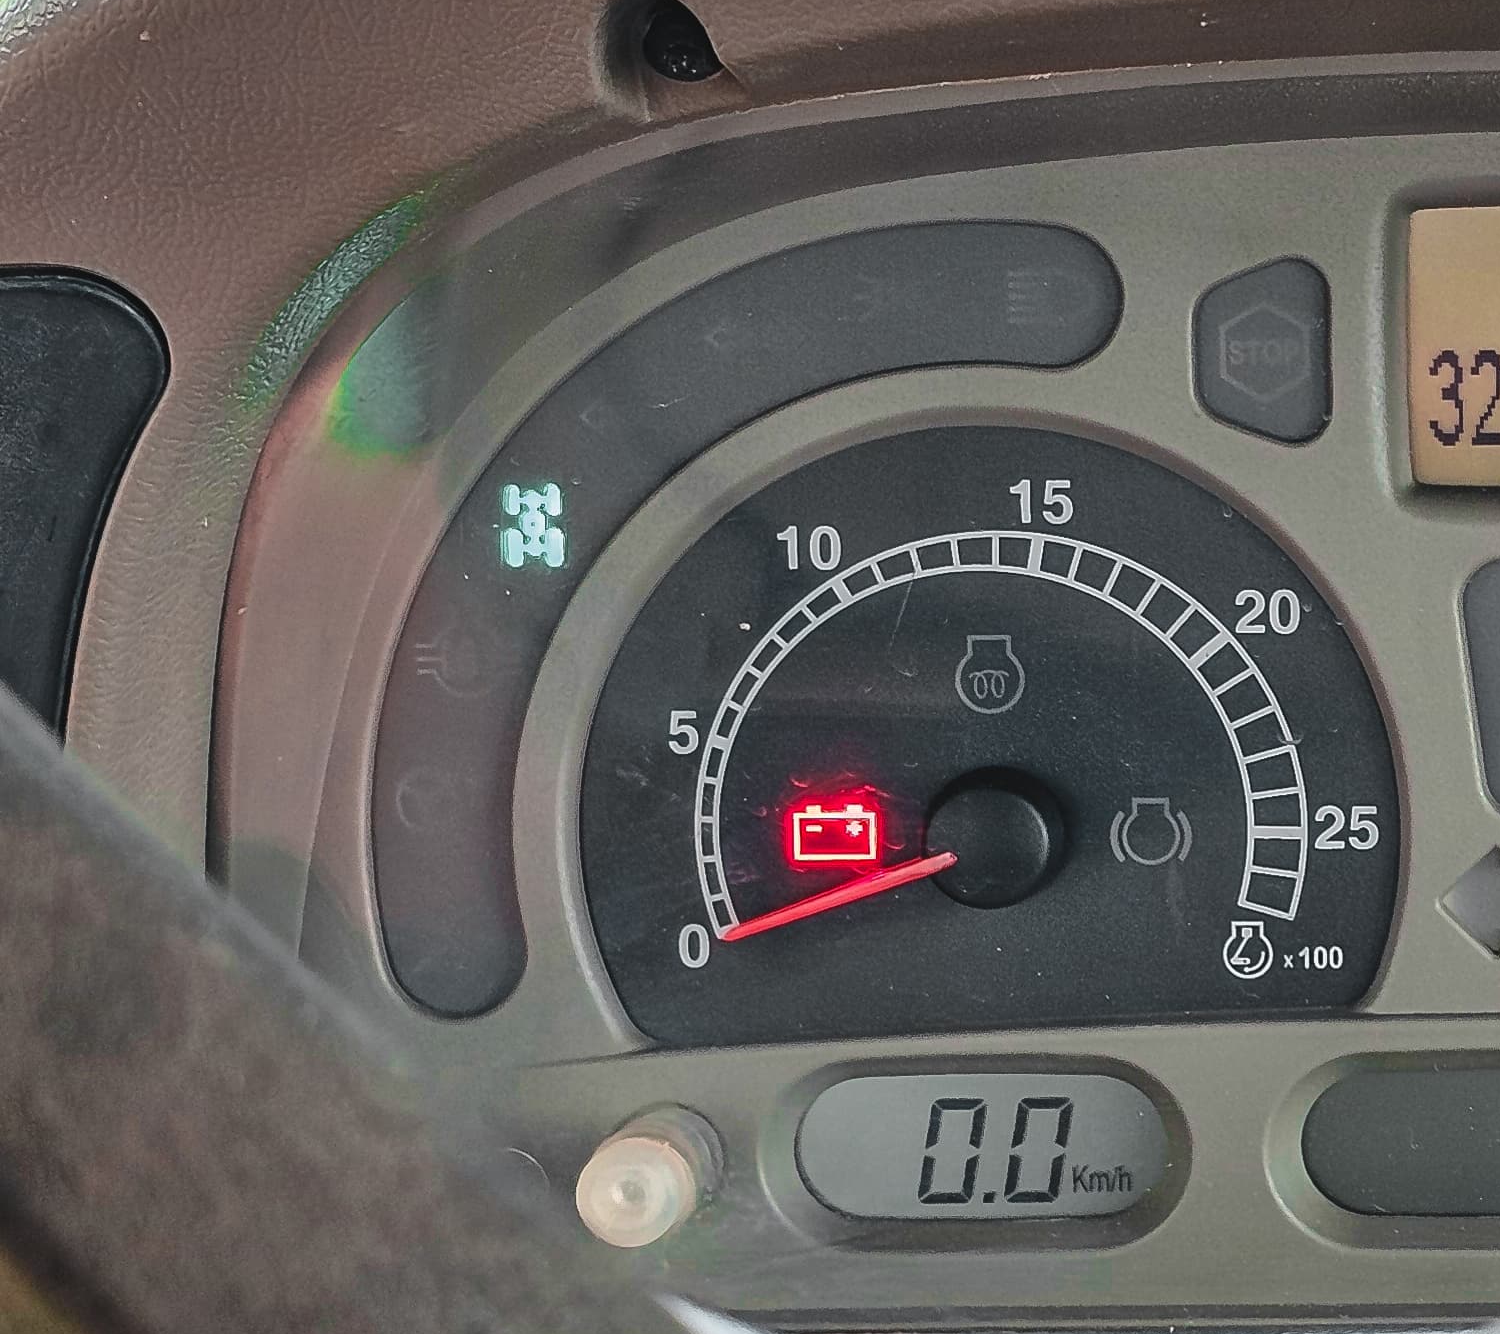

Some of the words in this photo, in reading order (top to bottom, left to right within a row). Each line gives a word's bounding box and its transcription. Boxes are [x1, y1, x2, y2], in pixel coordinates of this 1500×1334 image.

[1228, 338, 1303, 366] STOP
[1009, 478, 1075, 525] 15
[776, 525, 842, 571] 10
[1234, 588, 1301, 635] 20
[668, 710, 699, 755] 5
[1314, 804, 1379, 850] 25
[678, 923, 710, 969] 0
[917, 1096, 1074, 1204] 0.0
[1072, 1164, 1133, 1193] Km/h
